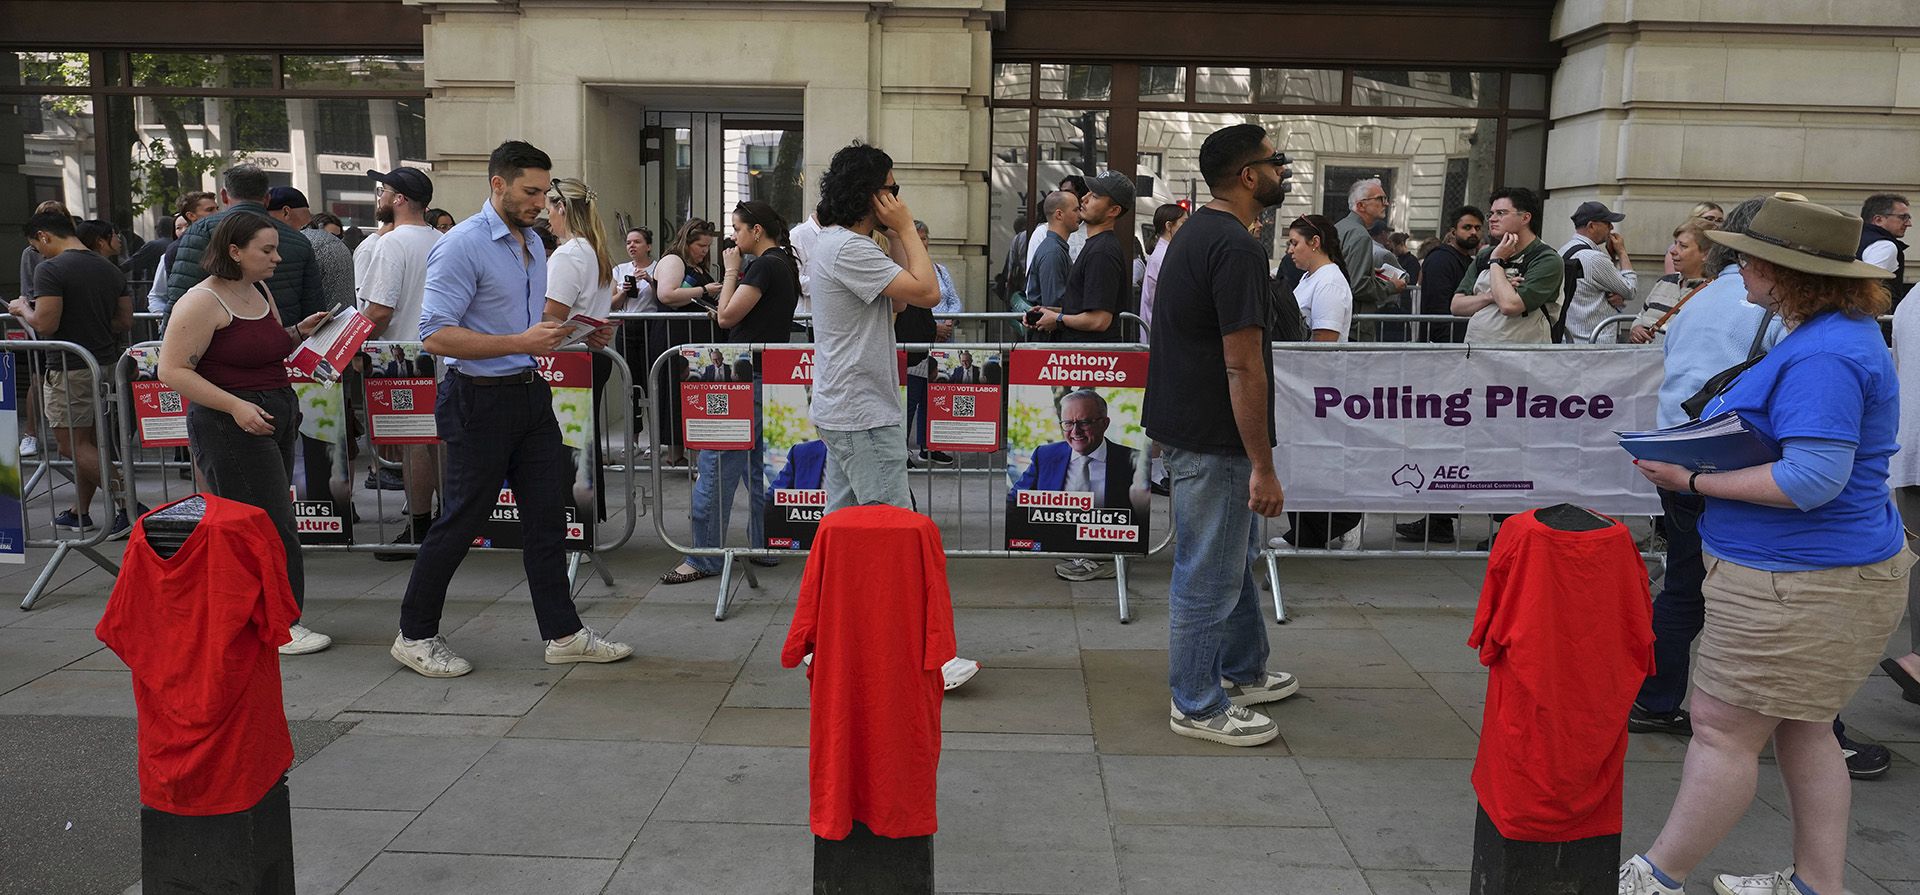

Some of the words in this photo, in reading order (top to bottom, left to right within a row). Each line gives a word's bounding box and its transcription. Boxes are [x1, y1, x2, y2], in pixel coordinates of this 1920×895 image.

[1047, 353, 1119, 370] Anthony
[1038, 366, 1127, 382] Albanese
[1313, 385, 1473, 427] Polling
[1485, 385, 1614, 420] Place
[1433, 465, 1470, 480] AEC
[777, 491, 828, 504] Buildi
[1019, 492, 1092, 511] Building
[297, 519, 340, 531] uture
[1079, 526, 1136, 540] Future
[1010, 540, 1031, 548] Labor
